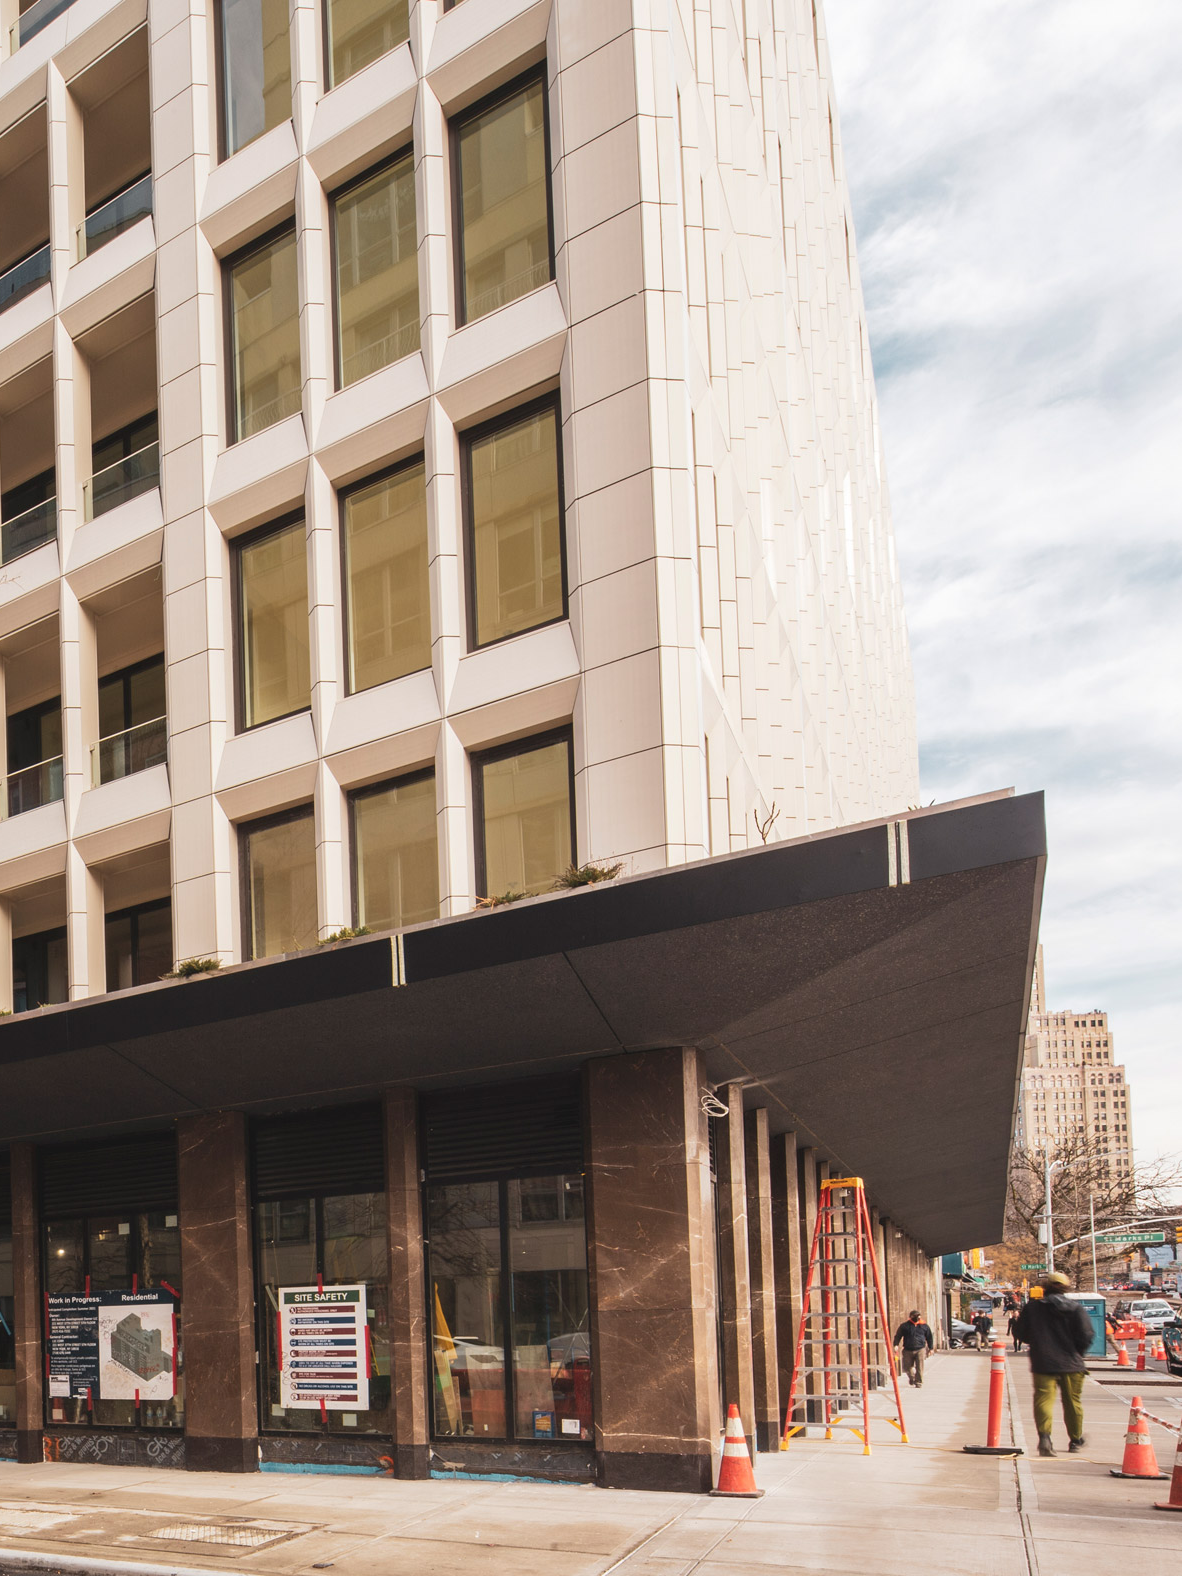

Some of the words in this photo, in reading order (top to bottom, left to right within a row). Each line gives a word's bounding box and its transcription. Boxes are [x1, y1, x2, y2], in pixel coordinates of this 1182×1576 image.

[71, 1296, 102, 1304] Progress:
[121, 1293, 159, 1301] Residential
[294, 1293, 313, 1302] SITE
[314, 1292, 348, 1301] SAFETY
